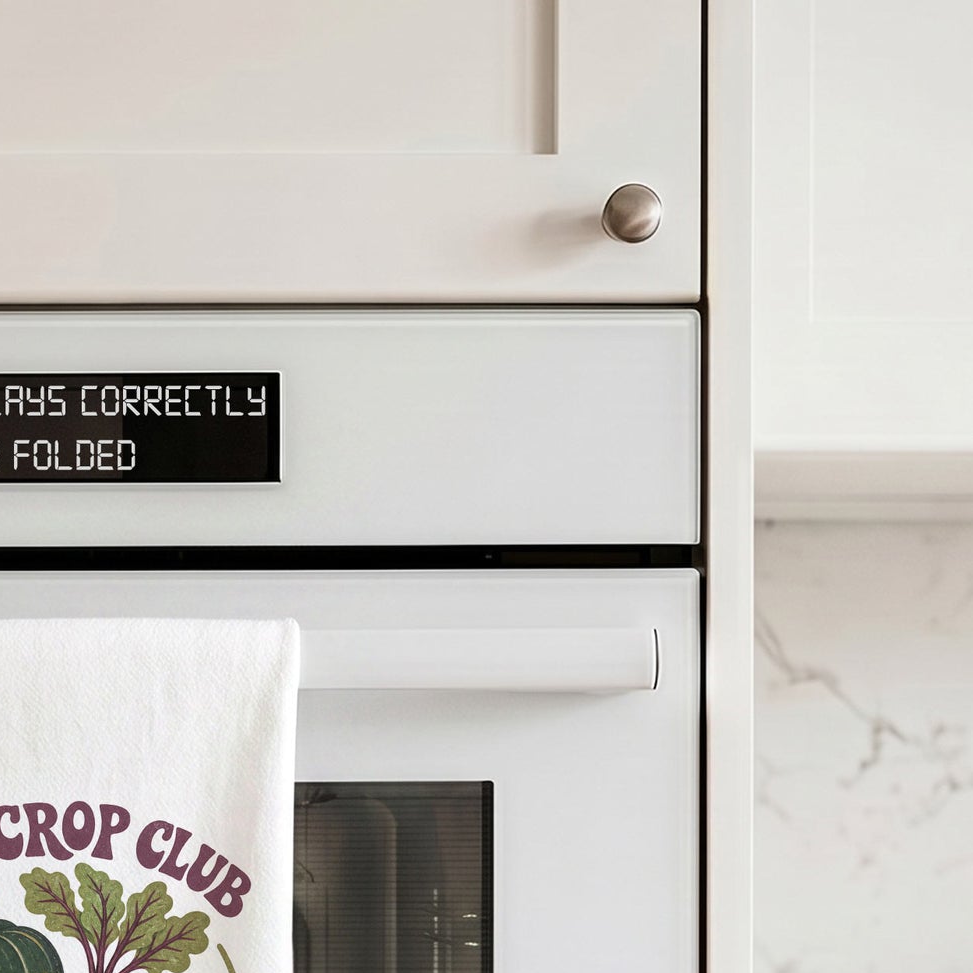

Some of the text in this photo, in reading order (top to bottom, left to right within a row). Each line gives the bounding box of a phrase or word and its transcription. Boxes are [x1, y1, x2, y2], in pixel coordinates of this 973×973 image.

[80, 385, 266, 417] CORRECTLY
[13, 439, 136, 471] FOLDED
[136, 820, 252, 918] CLUB
